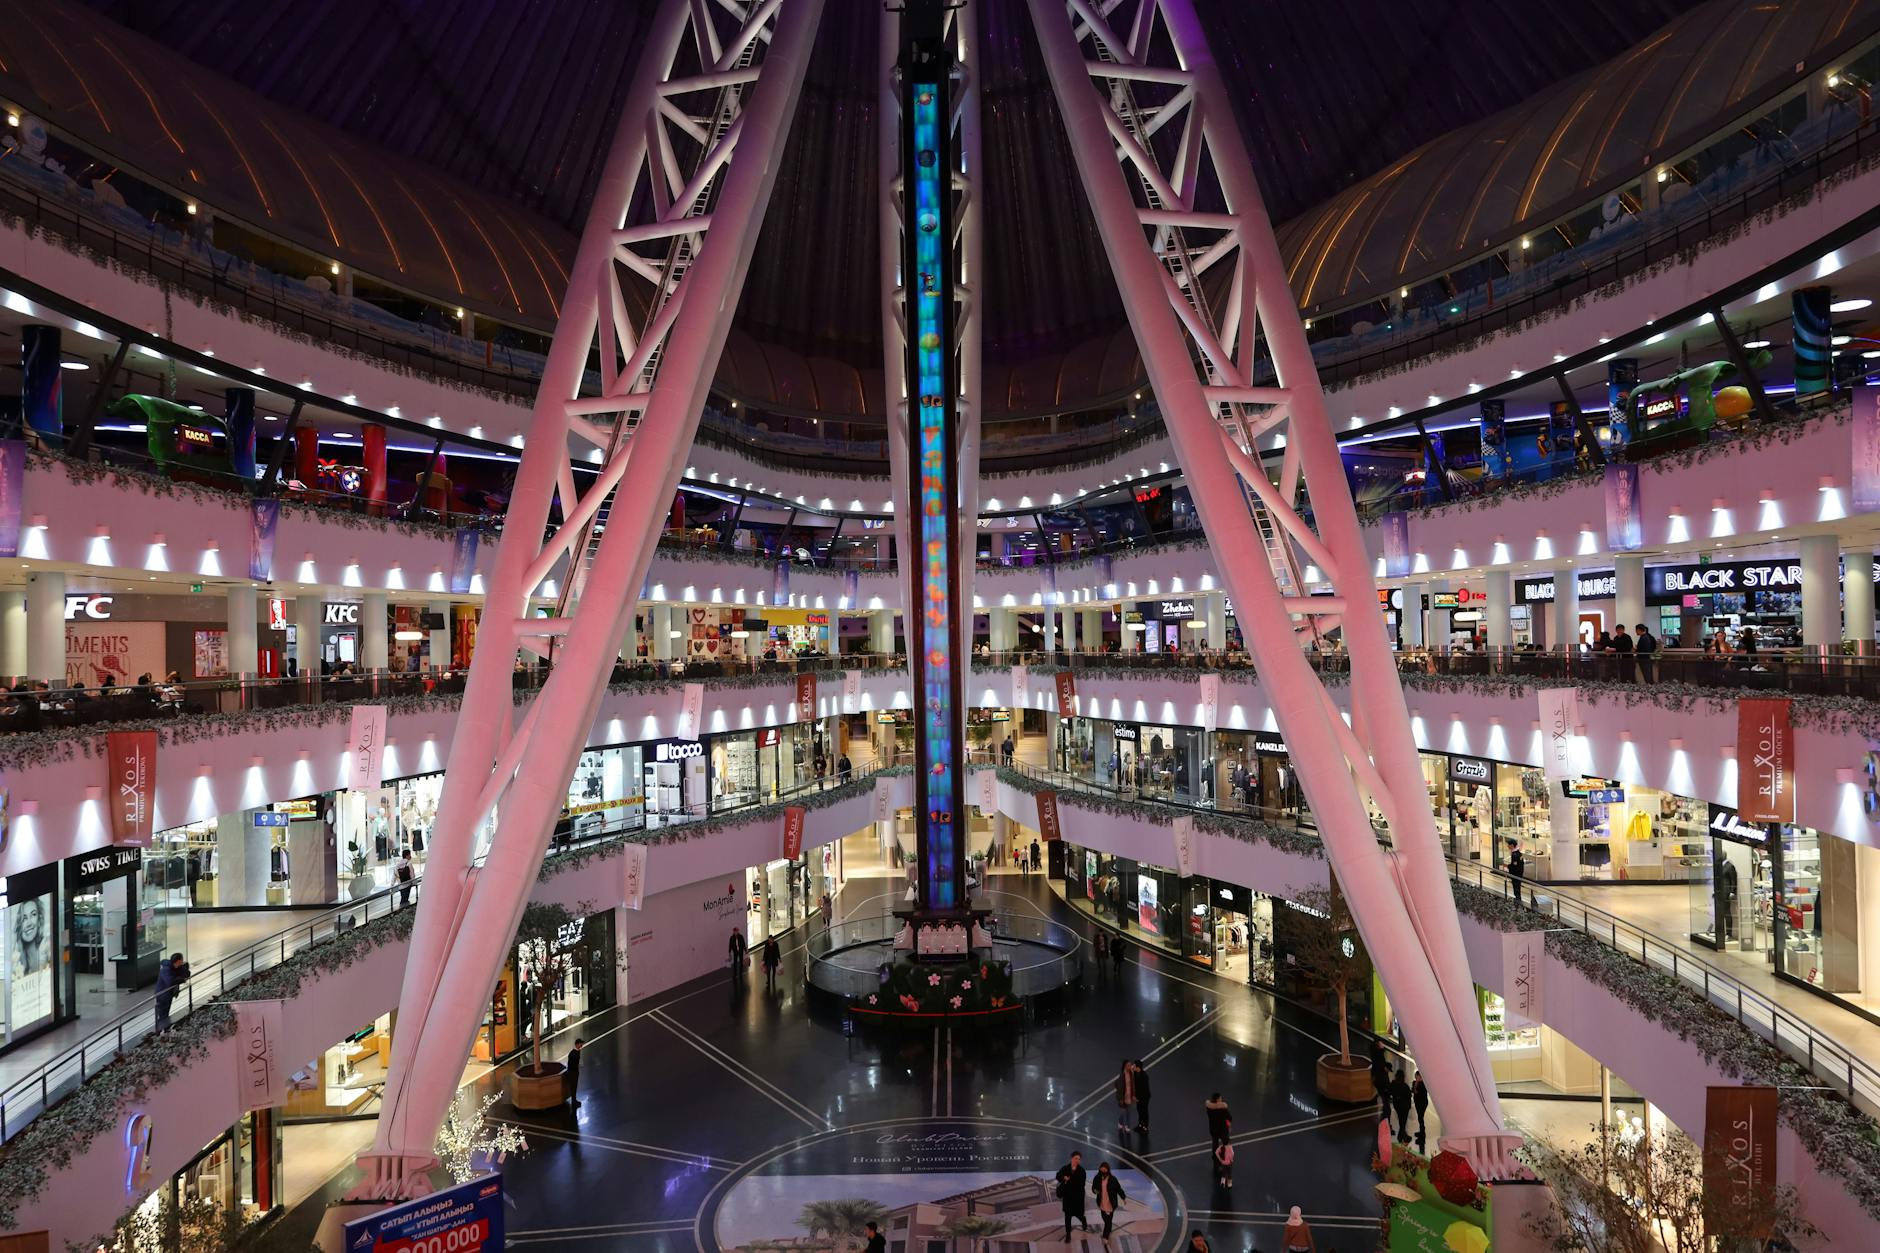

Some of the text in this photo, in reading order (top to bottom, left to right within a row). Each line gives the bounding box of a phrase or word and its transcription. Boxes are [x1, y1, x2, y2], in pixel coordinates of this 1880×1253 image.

[1647, 400, 1675, 415] КАССА
[185, 429, 210, 443] КАССА
[1665, 566, 1802, 590] BLACK STAR
[64, 597, 113, 619] FC
[324, 605, 358, 623] KFC
[1162, 601, 1195, 613] Zheka's
[359, 724, 373, 772] RIXOS
[1553, 710, 1567, 761] RIXOS
[1455, 760, 1488, 778] Grazie
[1753, 726, 1775, 795] RIXOS
[121, 756, 137, 822] RIXOS
[81, 848, 140, 876] SWISS TIME
[1515, 953, 1530, 1010] RIXOS
[248, 1026, 267, 1088] RIXOS
[1725, 1120, 1752, 1206] RIXOS
[380, 1212, 412, 1230] САТЫП
